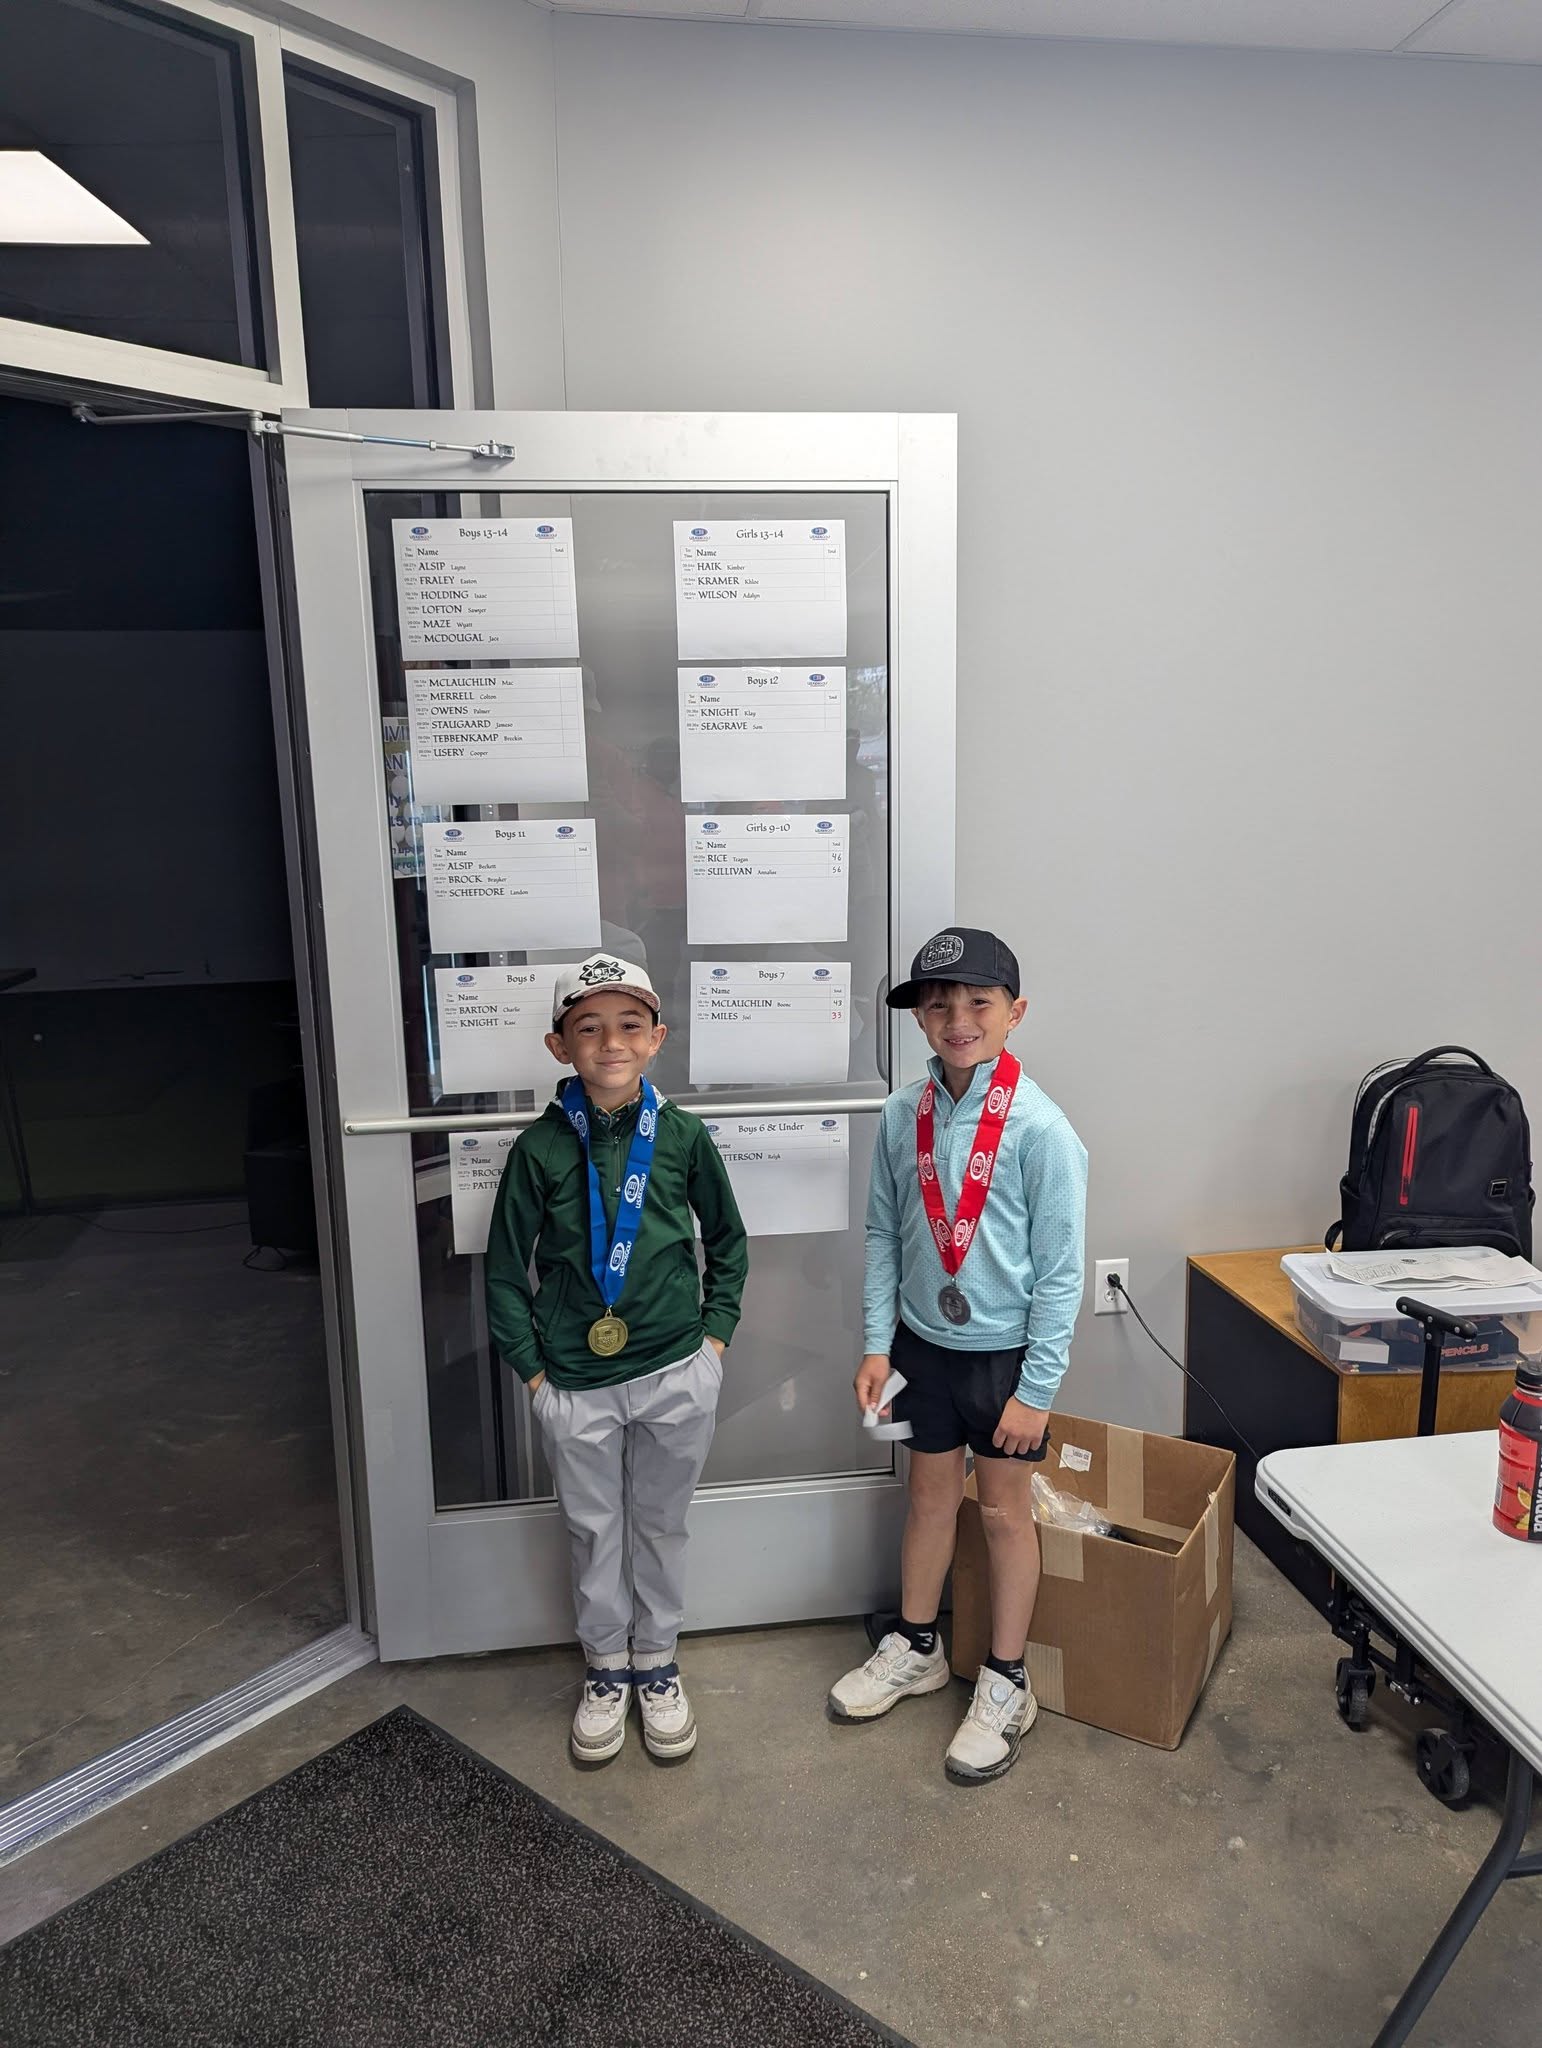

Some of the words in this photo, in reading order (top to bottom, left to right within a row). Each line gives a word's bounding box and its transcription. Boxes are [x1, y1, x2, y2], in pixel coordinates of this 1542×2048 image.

[459, 528, 481, 540] Boys
[483, 528, 508, 538] 13-14
[736, 530, 758, 538] Girls
[760, 530, 784, 540] 13-14
[417, 548, 439, 556] Name
[419, 562, 445, 570] ALSIP
[420, 577, 454, 585] FRALEY
[698, 577, 739, 585] KRAMER
[421, 591, 469, 599] HOLDING
[422, 605, 462, 613] LOFTON
[423, 620, 451, 628] MAZE
[424, 634, 484, 643] MCDOUGAL
[748, 677, 767, 687] Boys
[431, 707, 468, 715] OWENS
[432, 720, 491, 729] STAUGAARD
[701, 722, 747, 730] SEAGRAVE
[433, 734, 498, 743] TEBBENKAMP
[434, 749, 465, 757] USERY
[746, 823, 767, 832] Girls
[769, 824, 790, 833] 9-10
[495, 830, 516, 841] Boys
[448, 862, 474, 870] ALSIP
[450, 888, 505, 897] SCHEFDORE
[507, 975, 528, 985] Boys
[530, 974, 535, 982] 8
[759, 971, 778, 980] Boys
[460, 1006, 498, 1014] BARTON
[738, 1125, 757, 1134] Boys
[767, 1123, 776, 1131] &
[779, 1123, 804, 1131] Under
[498, 1138, 515, 1147] Girl
[723, 1153, 763, 1161] TTERSON
[473, 1182, 500, 1190] PATTE
[1441, 1343, 1489, 1358] ENCILS
